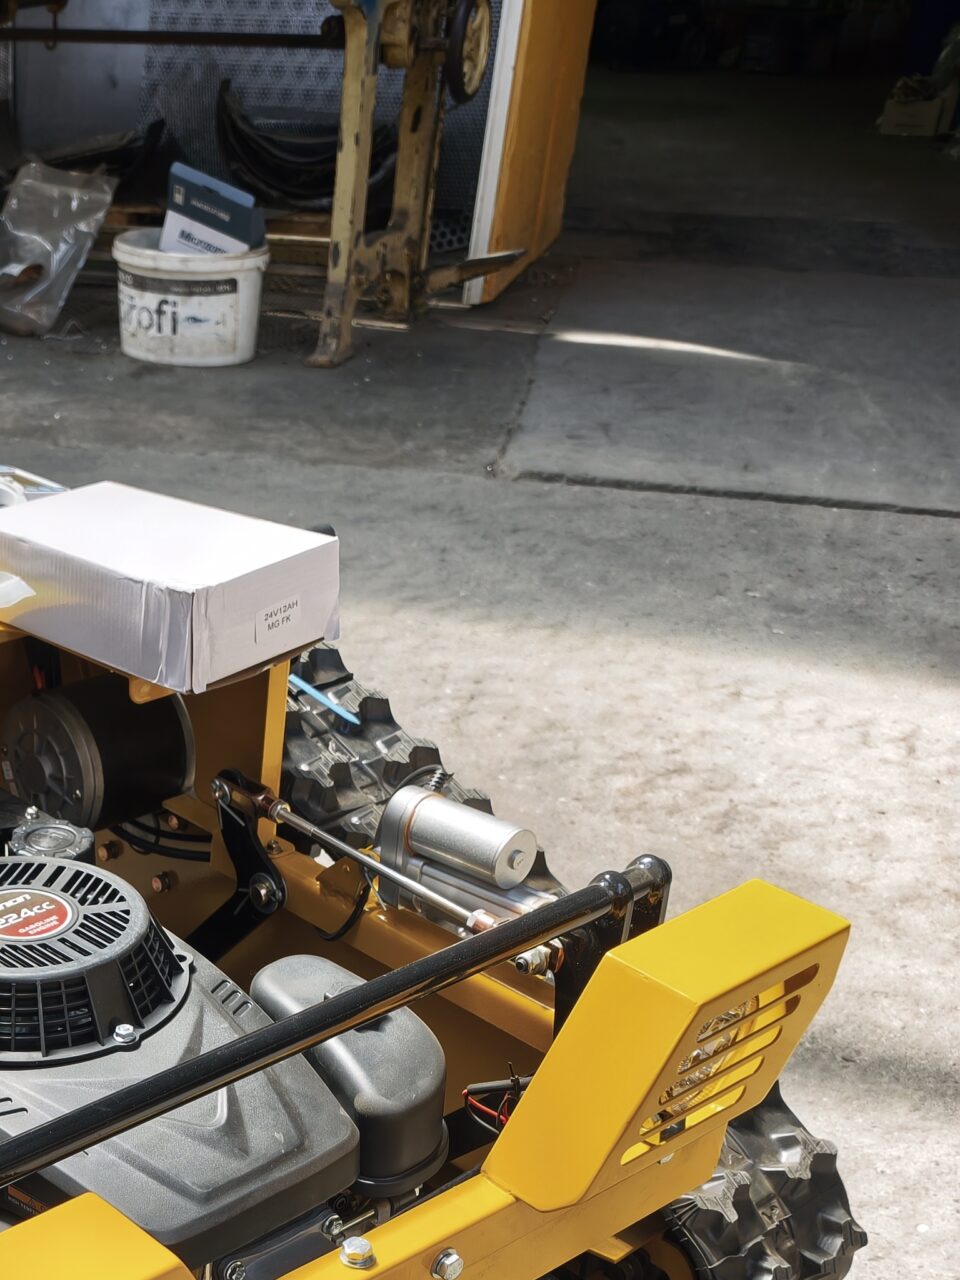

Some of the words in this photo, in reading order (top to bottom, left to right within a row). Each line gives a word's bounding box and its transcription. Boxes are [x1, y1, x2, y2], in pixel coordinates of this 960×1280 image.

[264, 600, 298, 621] 24V12AH
[267, 620, 280, 631] MG
[281, 614, 291, 624] FK
[19, 915, 59, 933] GASOLINE
